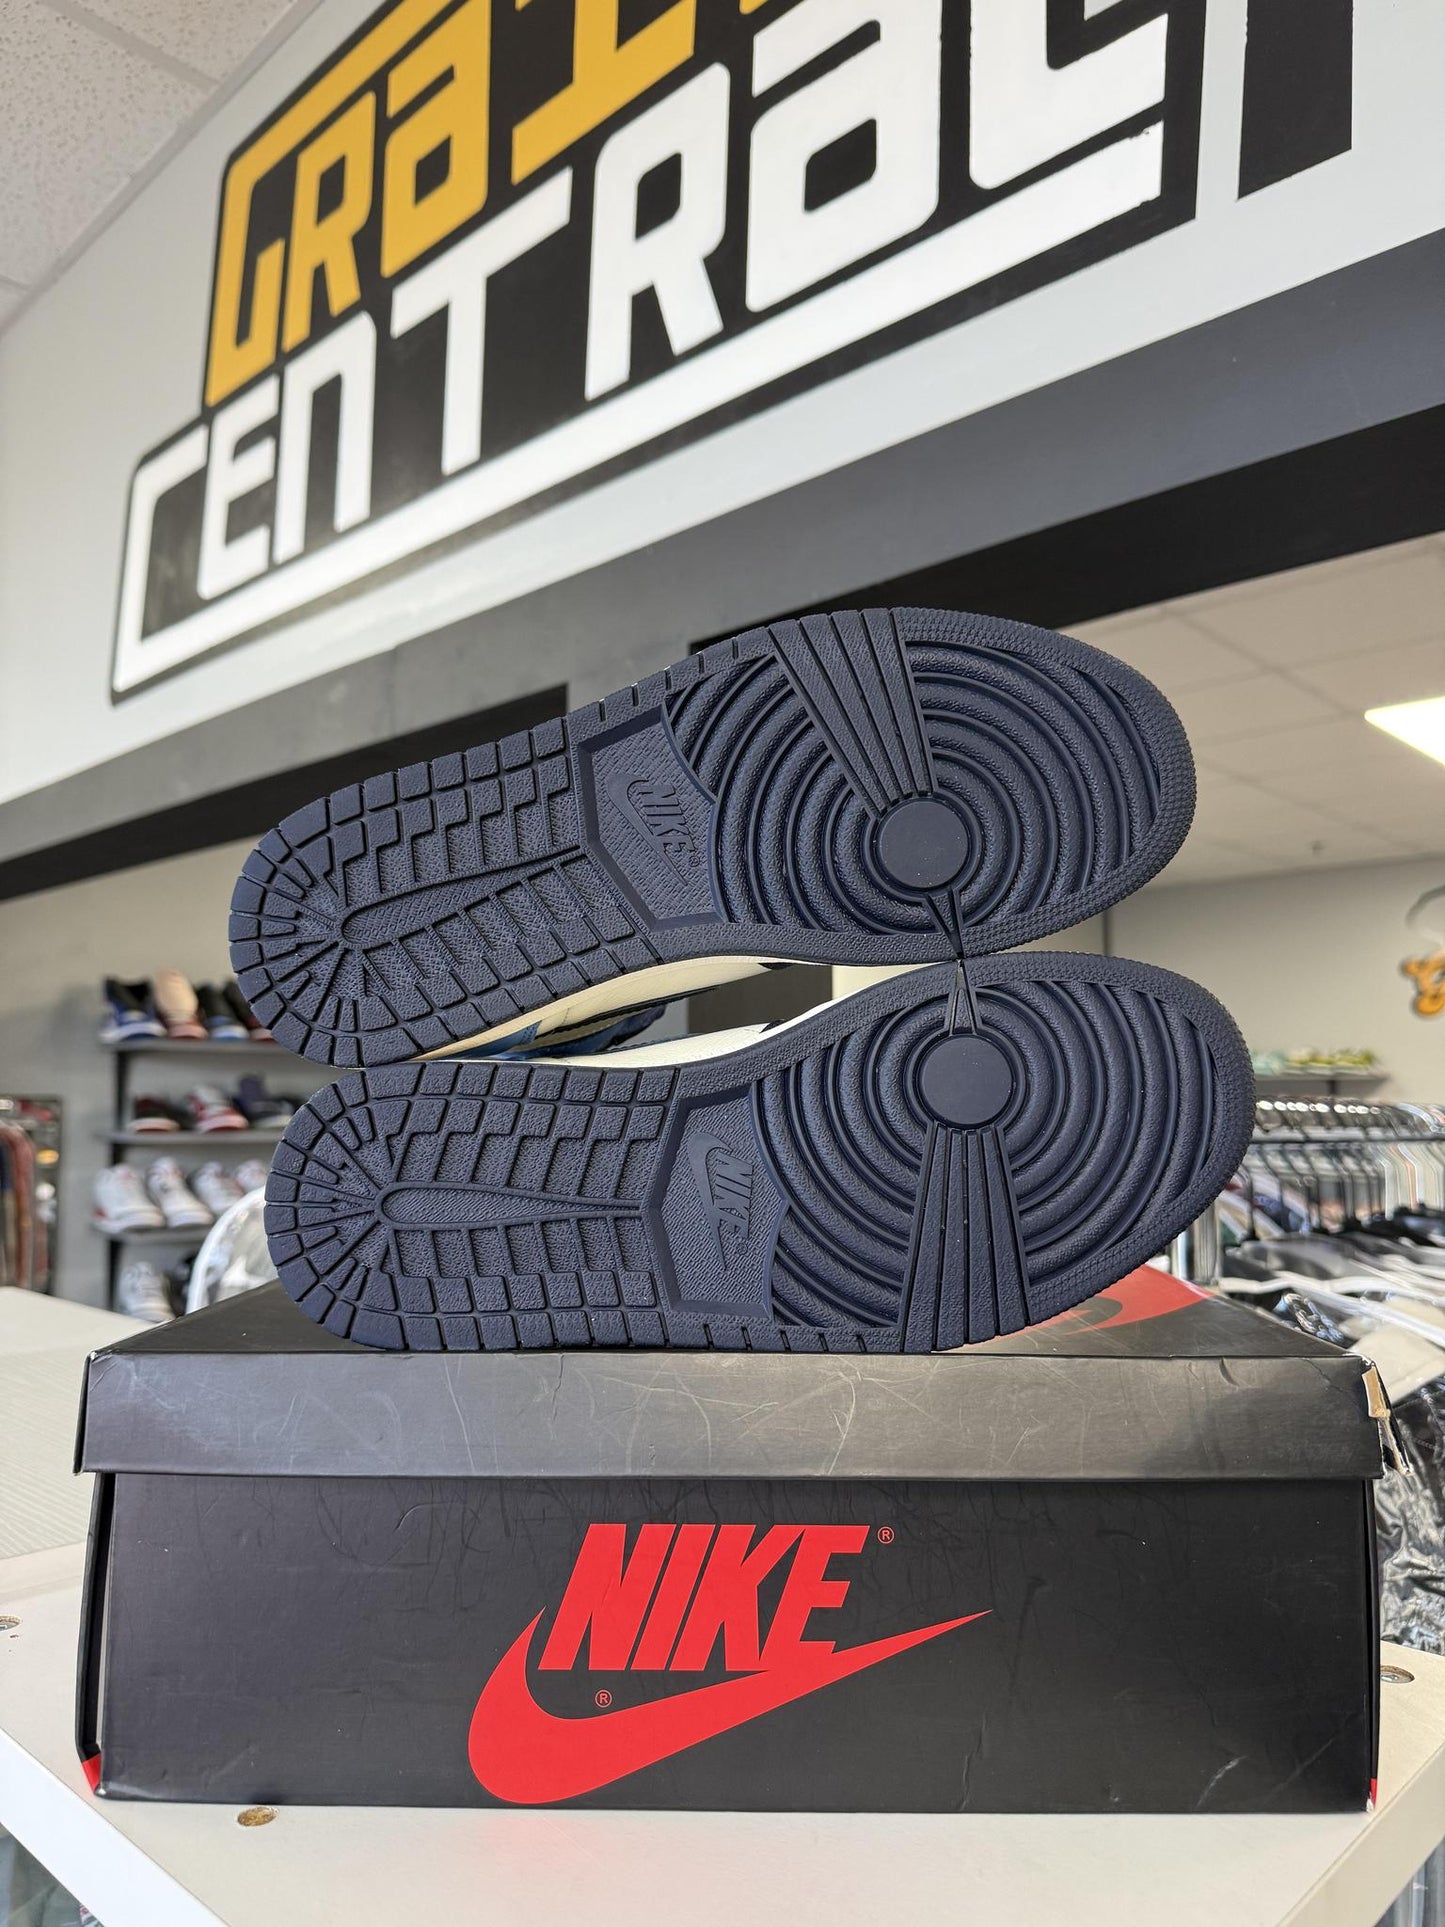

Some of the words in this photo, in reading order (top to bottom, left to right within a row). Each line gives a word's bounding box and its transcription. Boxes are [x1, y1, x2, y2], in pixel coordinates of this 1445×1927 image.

[635, 783, 697, 854] NIKE
[713, 1151, 753, 1240] NIKE
[537, 1523, 871, 1671] NIKE
